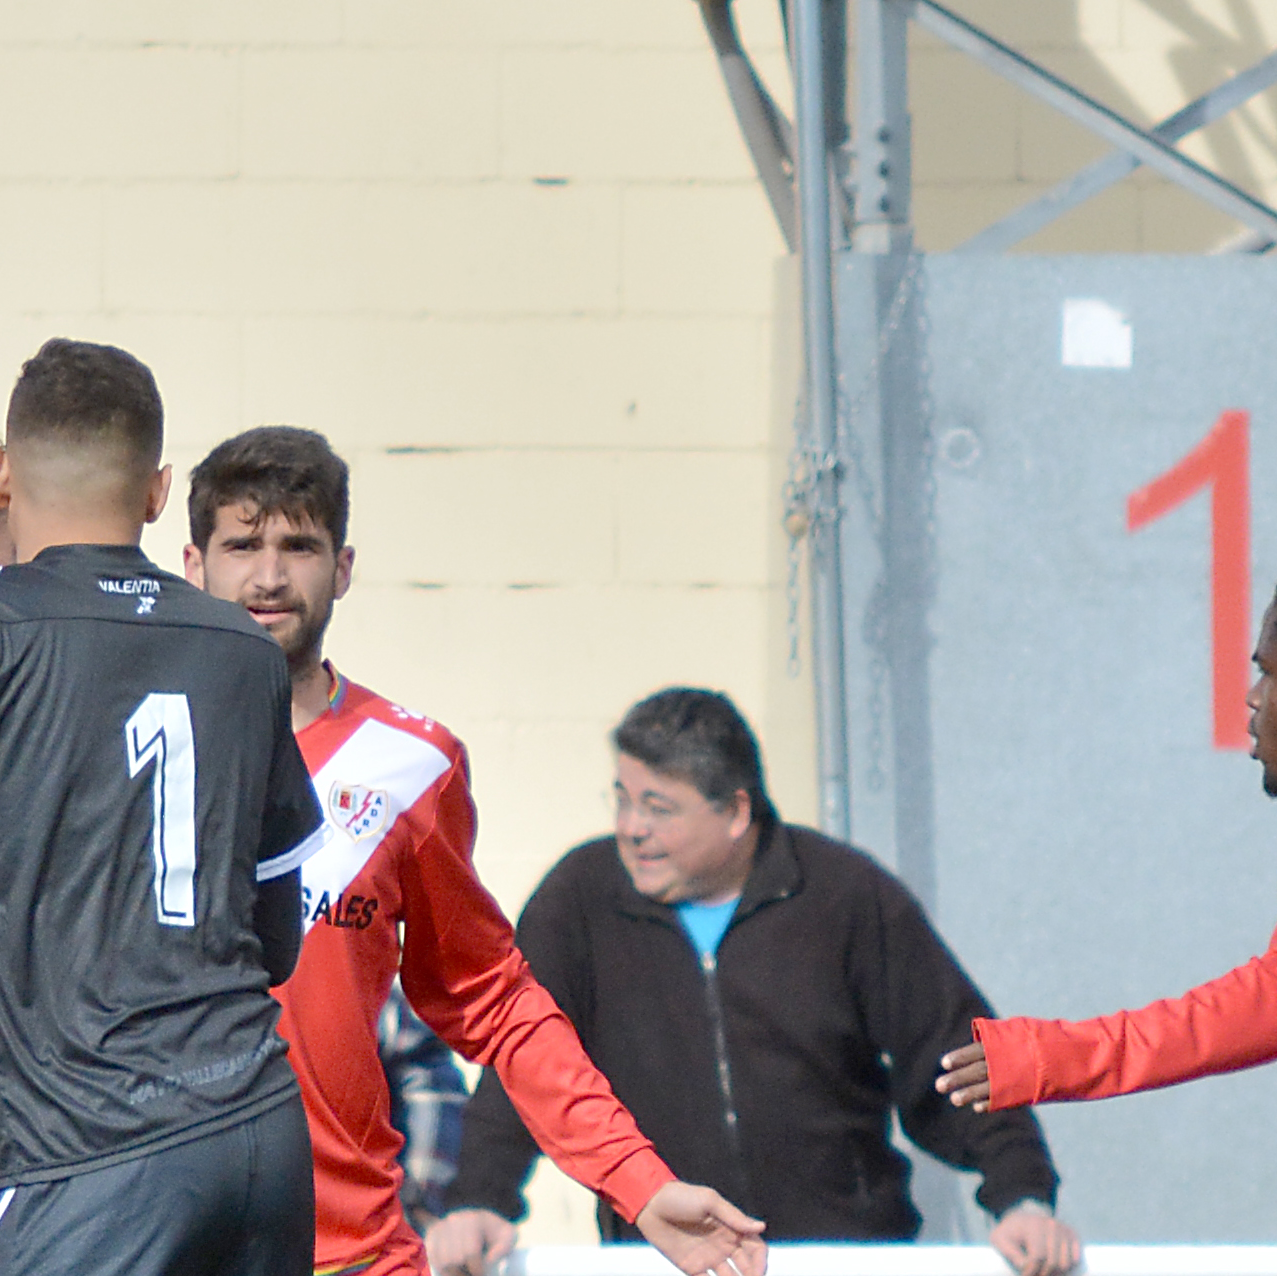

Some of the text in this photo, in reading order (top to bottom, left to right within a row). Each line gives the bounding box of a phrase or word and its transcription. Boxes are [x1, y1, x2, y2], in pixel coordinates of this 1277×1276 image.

[98, 580, 161, 593] VALENTIA
[1125, 409, 1252, 752] 1
[125, 692, 196, 927] 1
